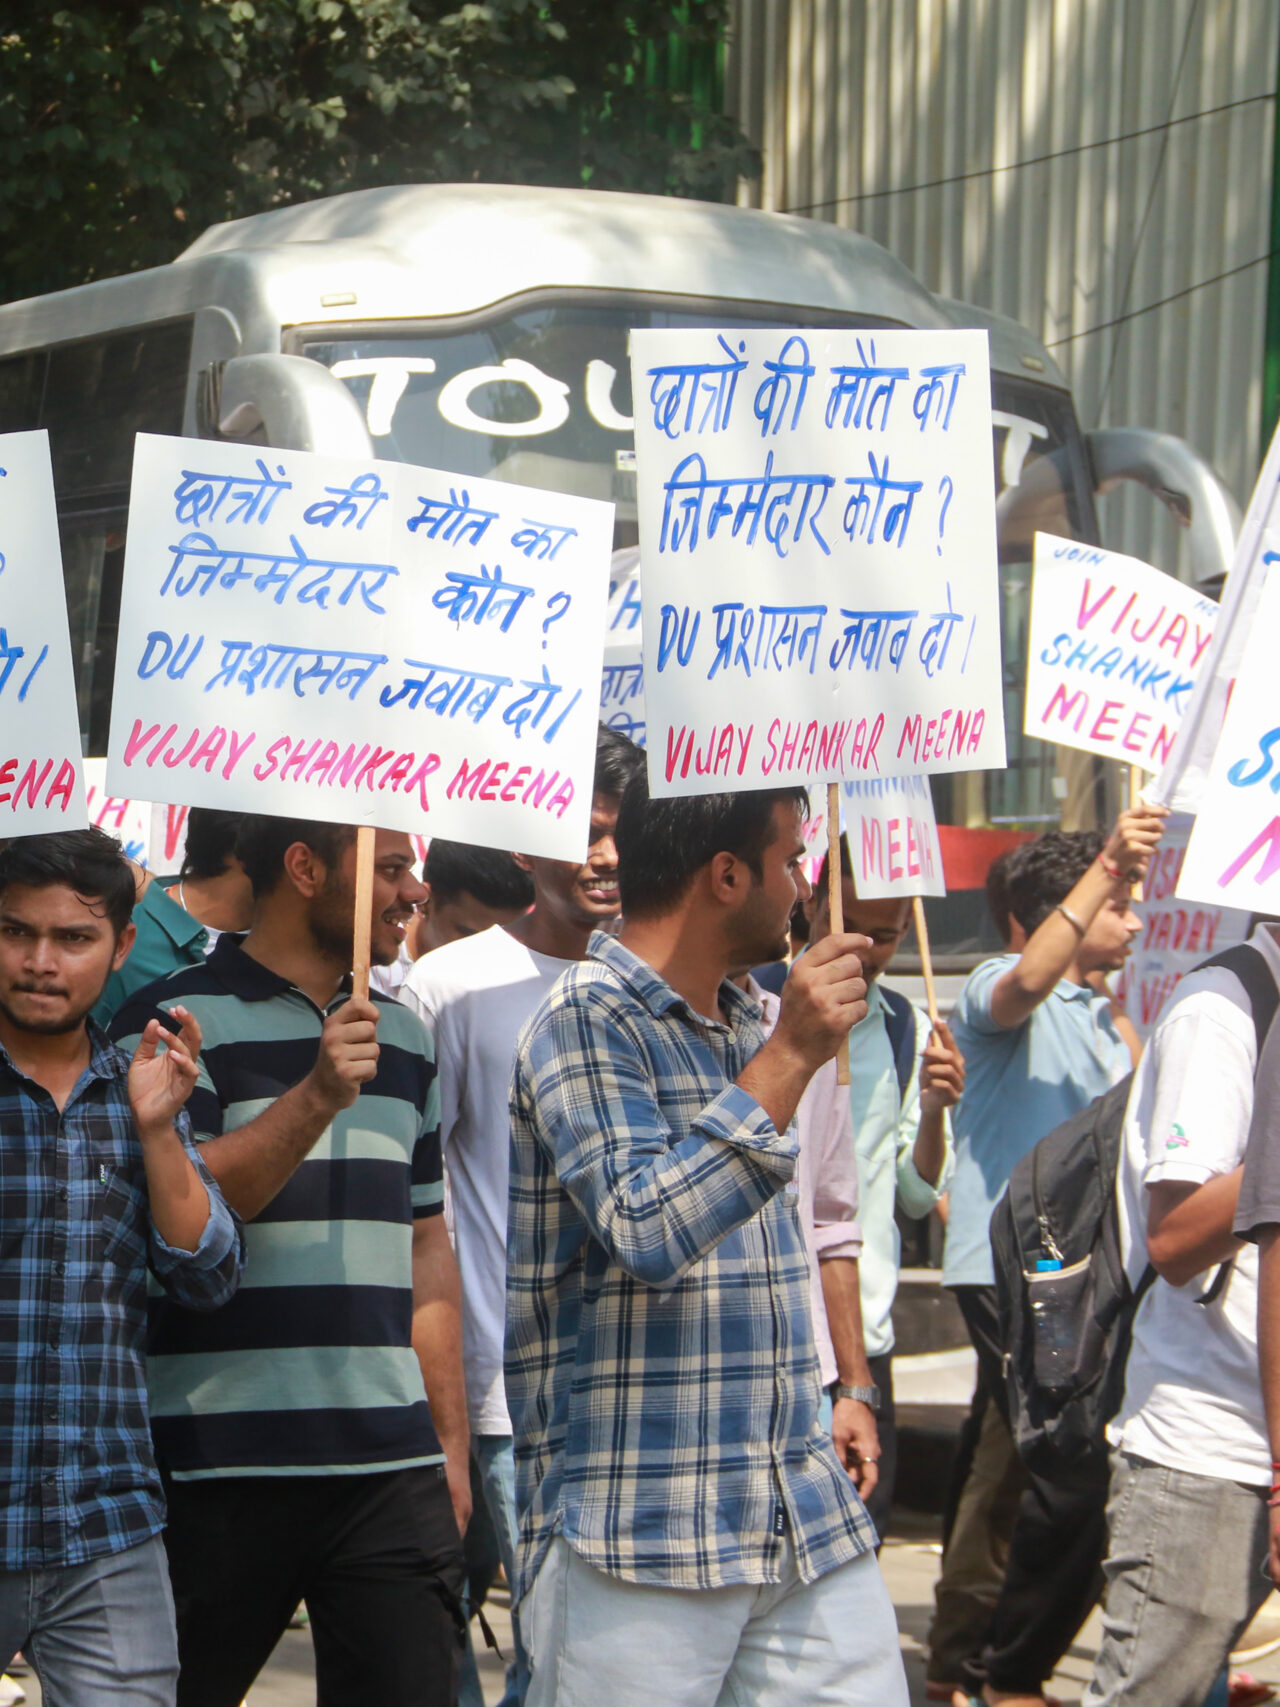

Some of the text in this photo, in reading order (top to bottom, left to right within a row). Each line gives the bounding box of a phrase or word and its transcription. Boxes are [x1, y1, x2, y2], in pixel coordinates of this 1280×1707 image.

[646, 334, 966, 439] छात्रों की मौत का
[173, 458, 578, 561] छात्रों की मौत का
[843, 450, 924, 549] कौन
[937, 475, 953, 556] ?
[431, 563, 535, 634] कौन
[541, 592, 572, 650] ?
[656, 603, 701, 673] DU
[707, 602, 827, 681] प्रशासन
[830, 609, 918, 673] जवाब
[136, 631, 205, 680] DU
[203, 640, 389, 700] प्रशासन
[379, 657, 513, 723] जवाब
[1041, 633, 1196, 720] SHANKK
[122, 718, 577, 818] VIJAY SHANKAR MEENA
[665, 723, 754, 783] VIJAY
[761, 712, 885, 776] SHANKAR
[897, 708, 985, 765] MEENA
[1042, 682, 1178, 767] MEEN
